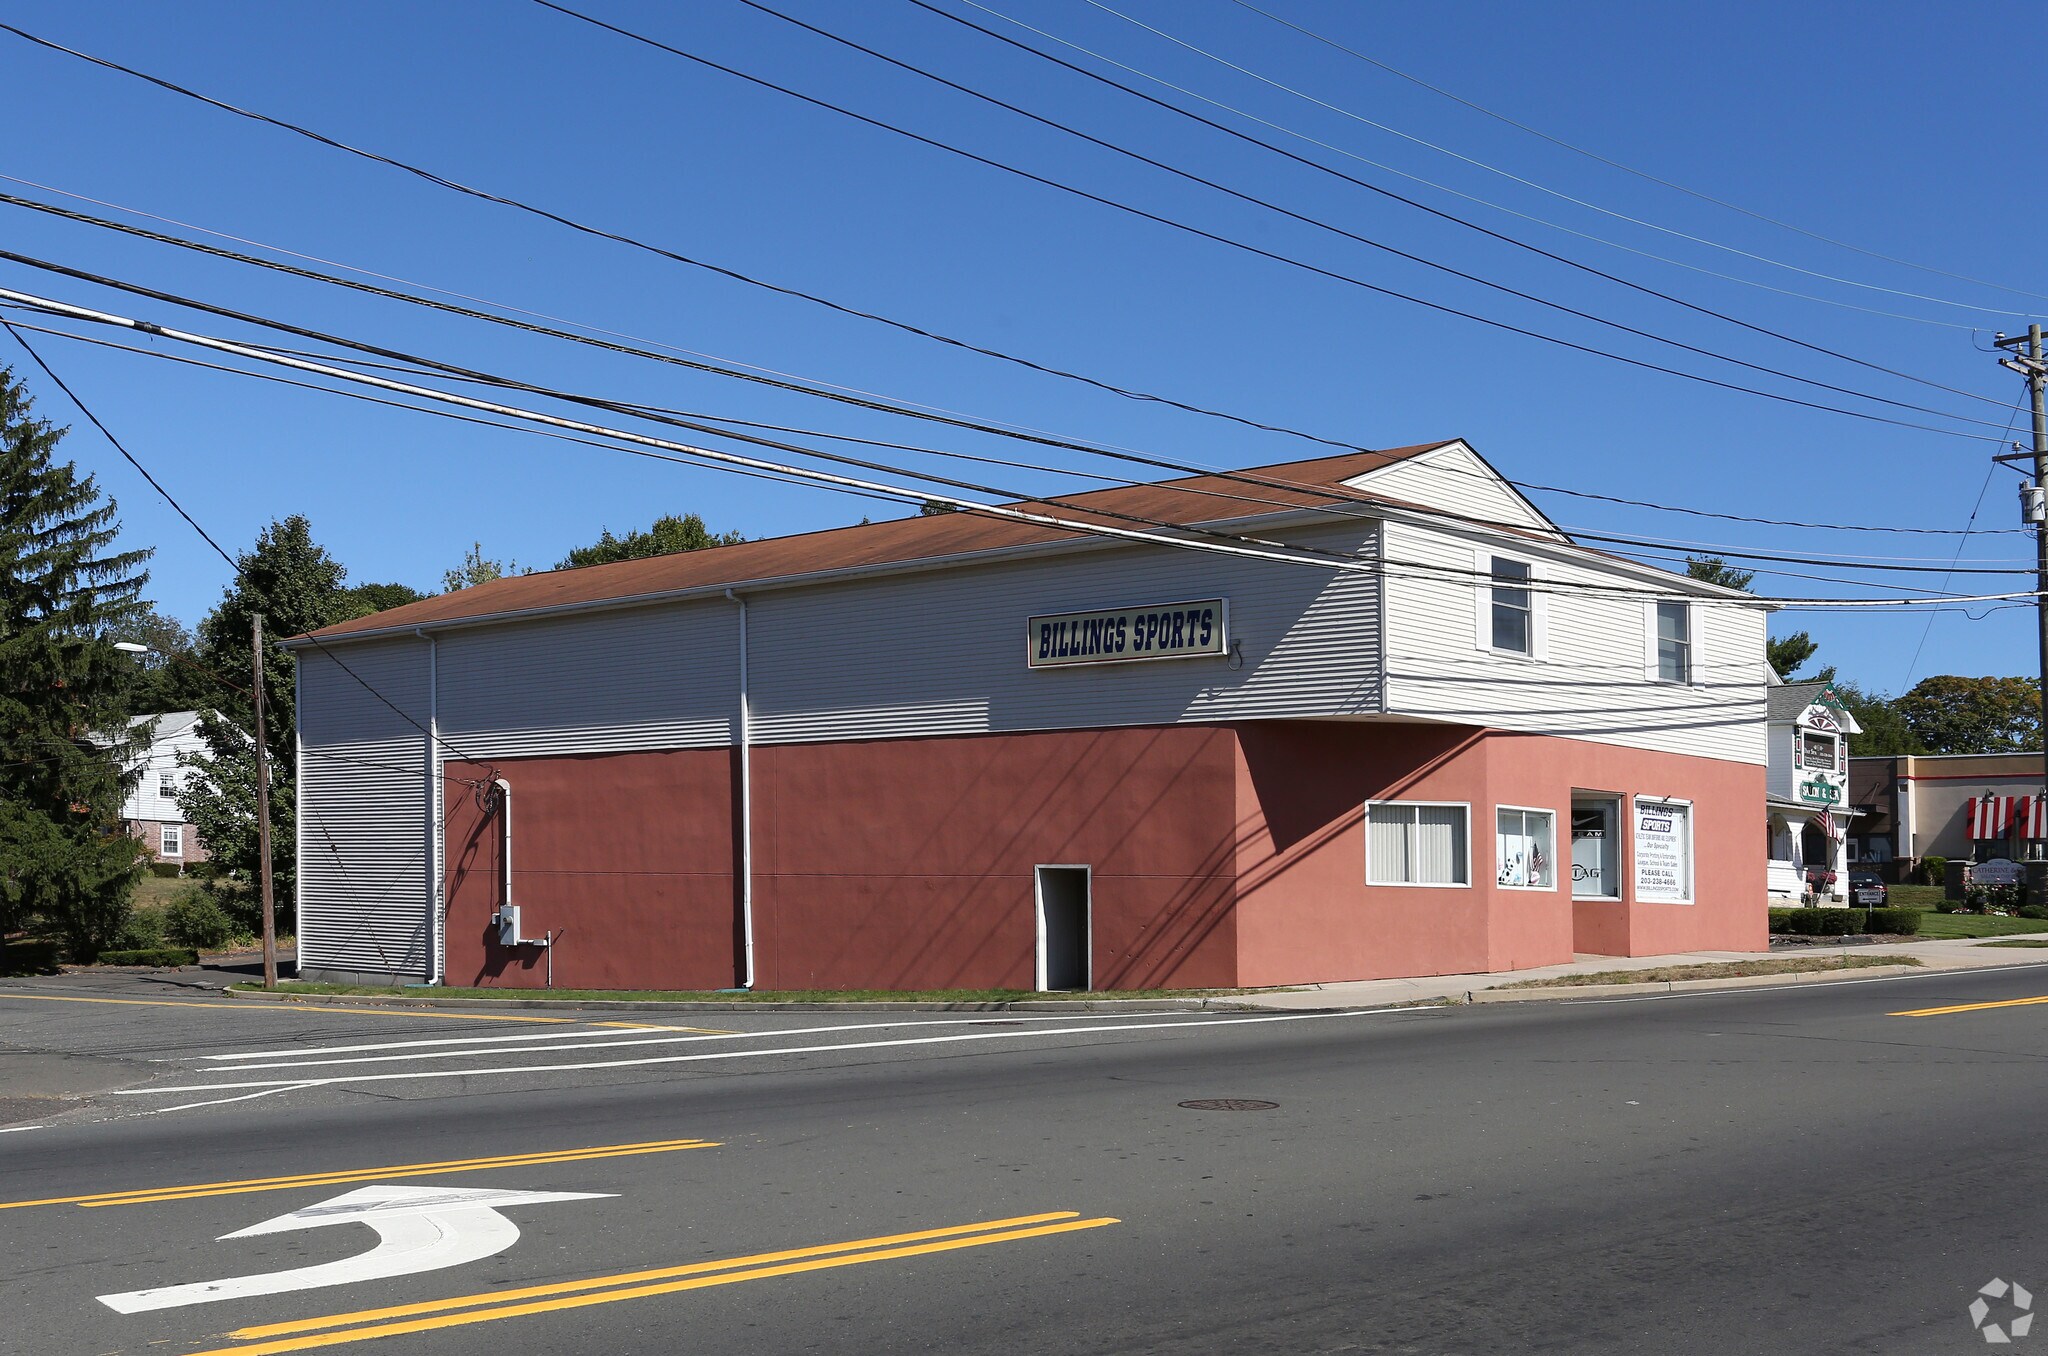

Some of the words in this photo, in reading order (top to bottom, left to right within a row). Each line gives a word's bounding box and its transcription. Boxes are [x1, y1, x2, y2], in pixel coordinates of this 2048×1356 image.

[1038, 616, 1127, 659] BILLINGS
[1133, 608, 1213, 652] SPORTS
[1640, 804, 1674, 818] BILLINGS
[1641, 819, 1671, 832] SPORTS
[1641, 869, 1661, 877] PLEASE
